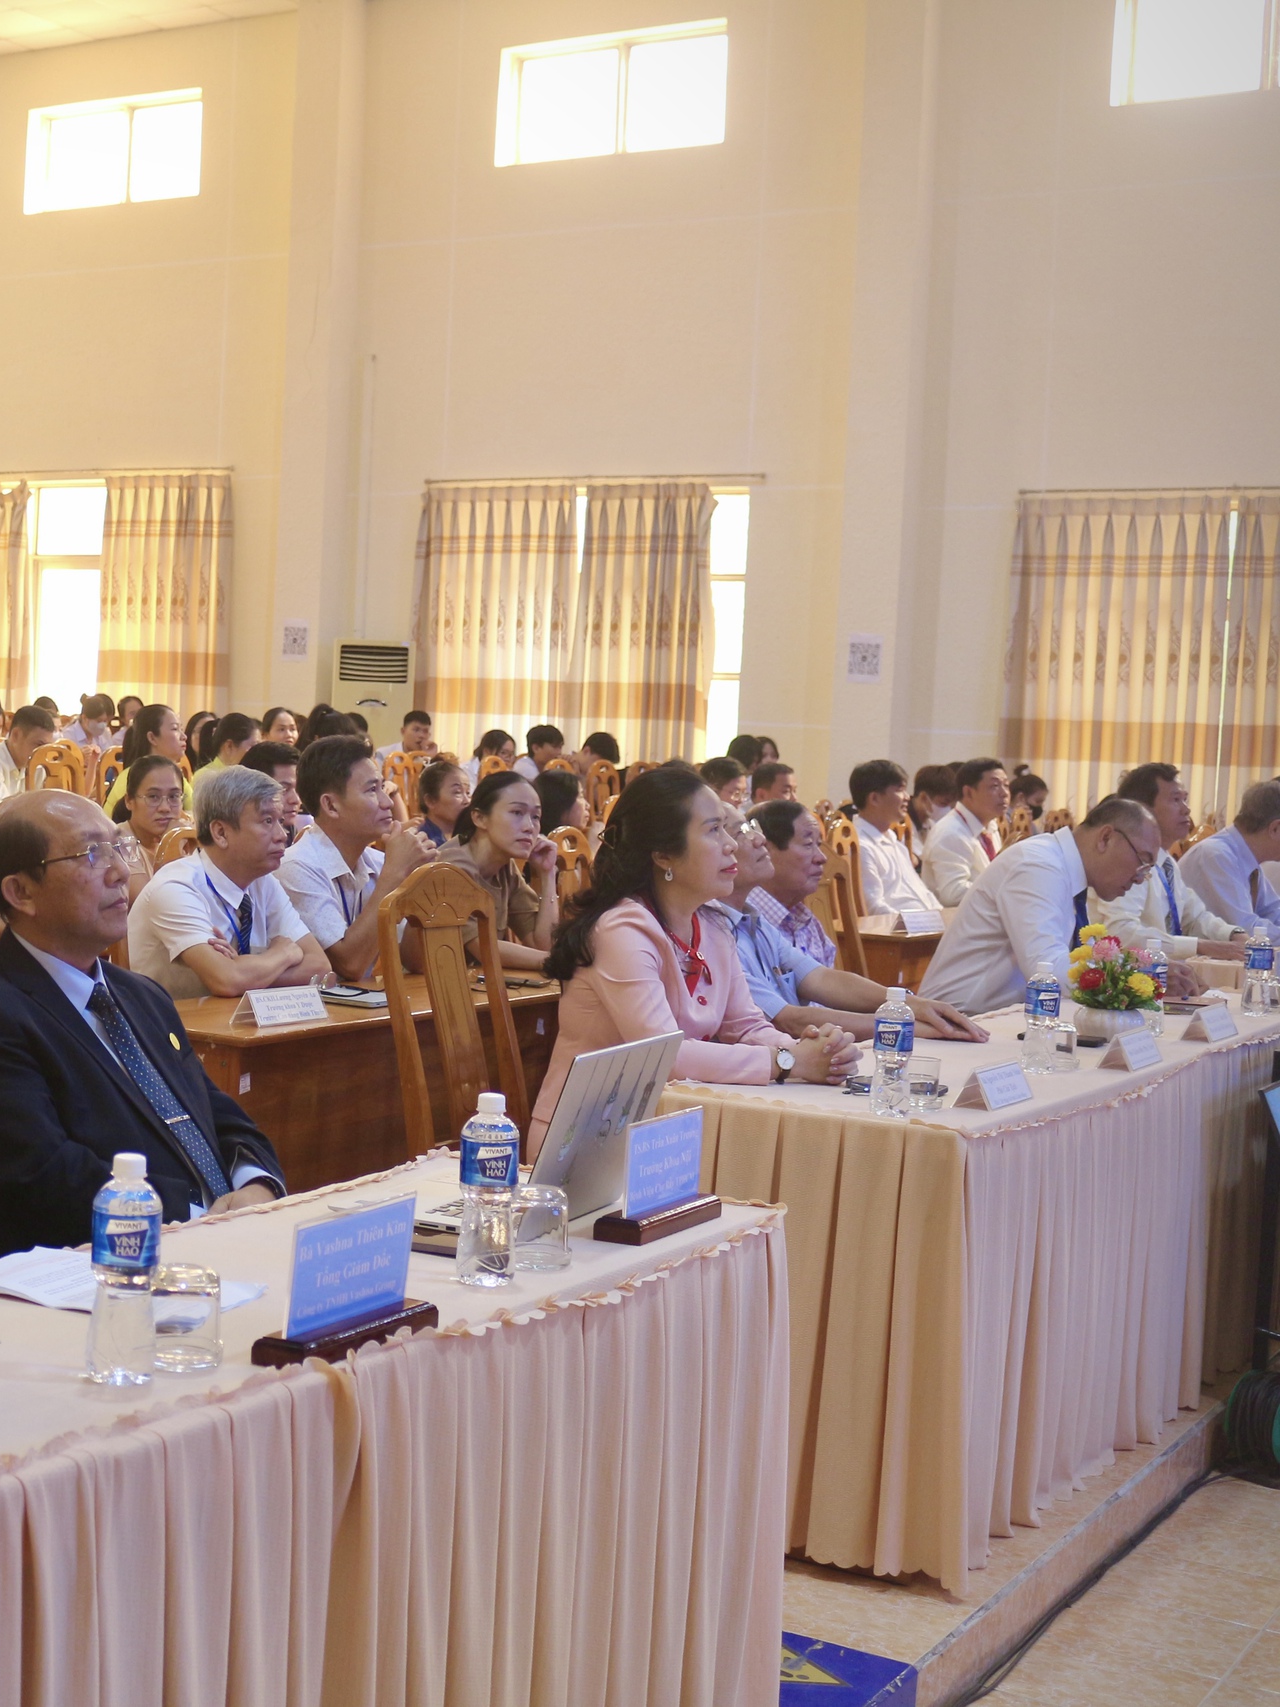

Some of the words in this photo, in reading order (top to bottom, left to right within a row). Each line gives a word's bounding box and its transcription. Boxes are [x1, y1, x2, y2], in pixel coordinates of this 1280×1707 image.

[300, 1244, 313, 1262] Bà
[317, 1237, 353, 1256] Vashna
[357, 1226, 383, 1245] Thiên
[316, 1266, 340, 1287] Tổng
[343, 1260, 370, 1279] Giám
